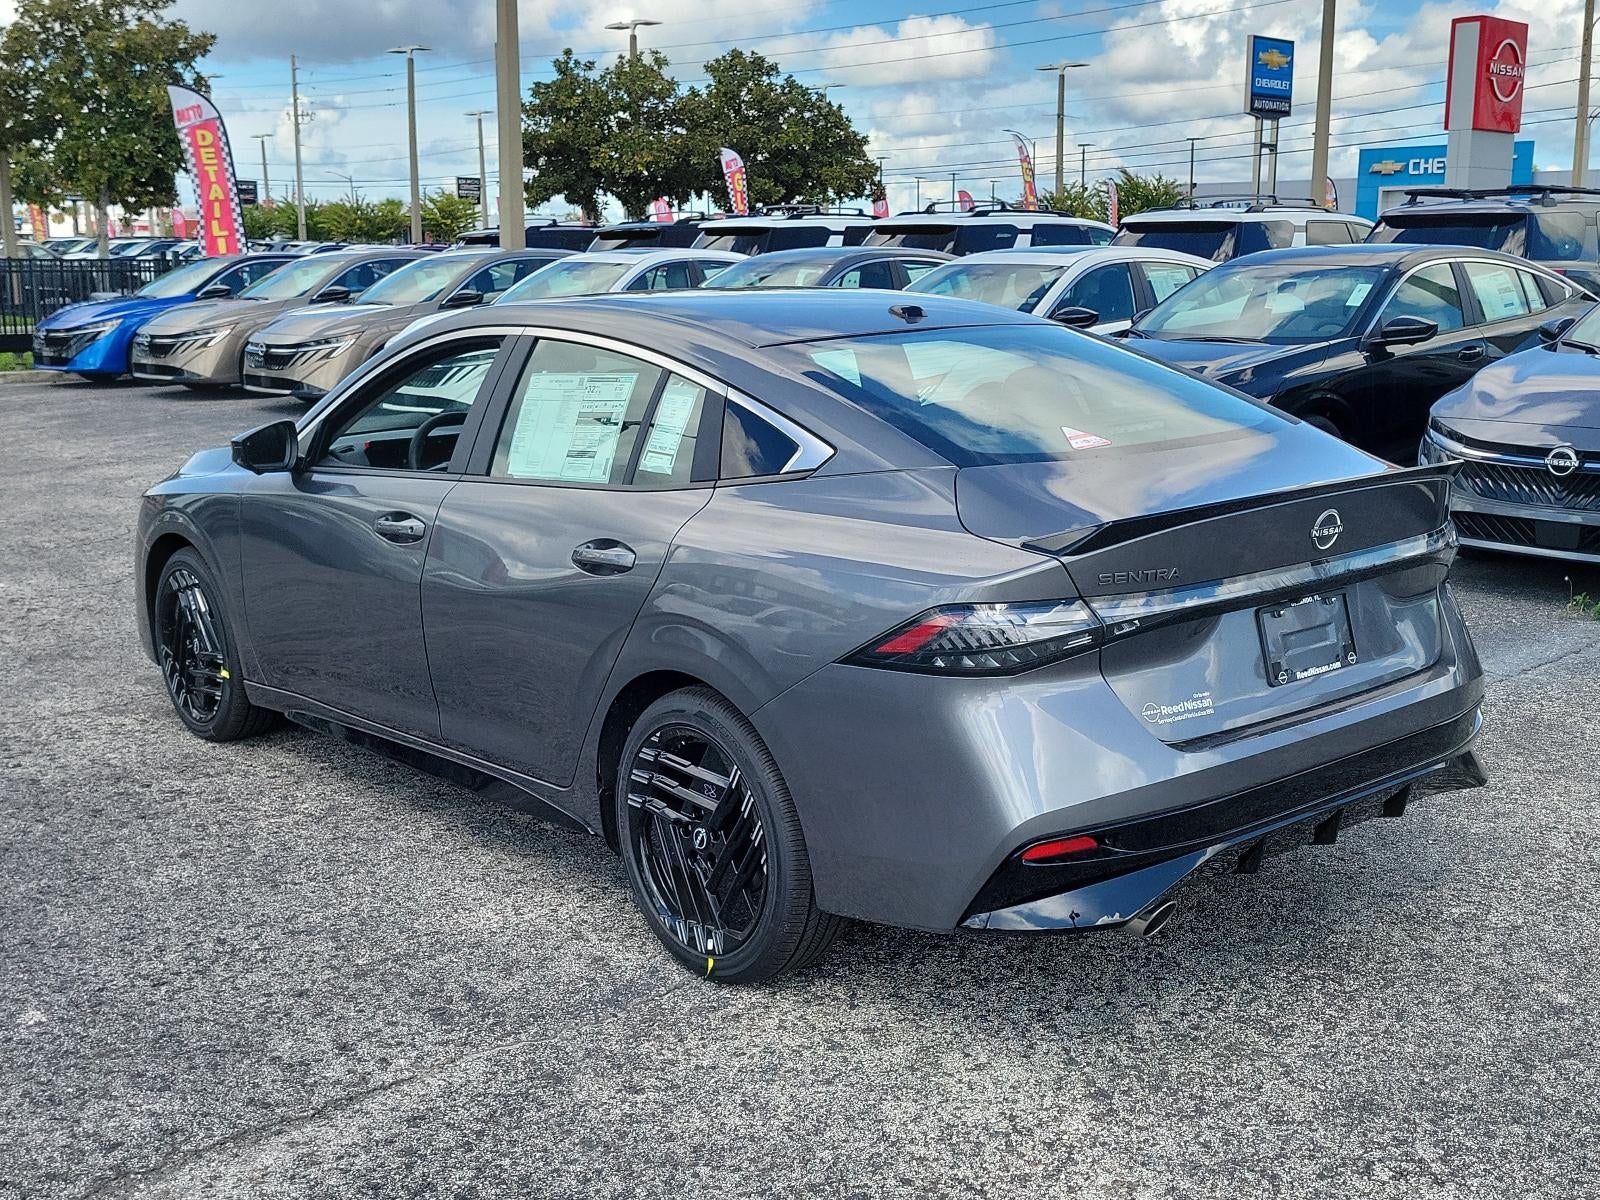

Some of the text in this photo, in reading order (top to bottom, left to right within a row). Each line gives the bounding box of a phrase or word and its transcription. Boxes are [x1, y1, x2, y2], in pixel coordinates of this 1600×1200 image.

[1490, 62, 1524, 78] NISSAN
[1255, 78, 1290, 90] CHEVROLET
[1254, 100, 1290, 111] AUTONATION
[1408, 157, 1447, 175] CHE
[1545, 457, 1579, 467] NISSAN
[1311, 524, 1343, 537] NISSAN
[1098, 567, 1180, 585] SENTRA
